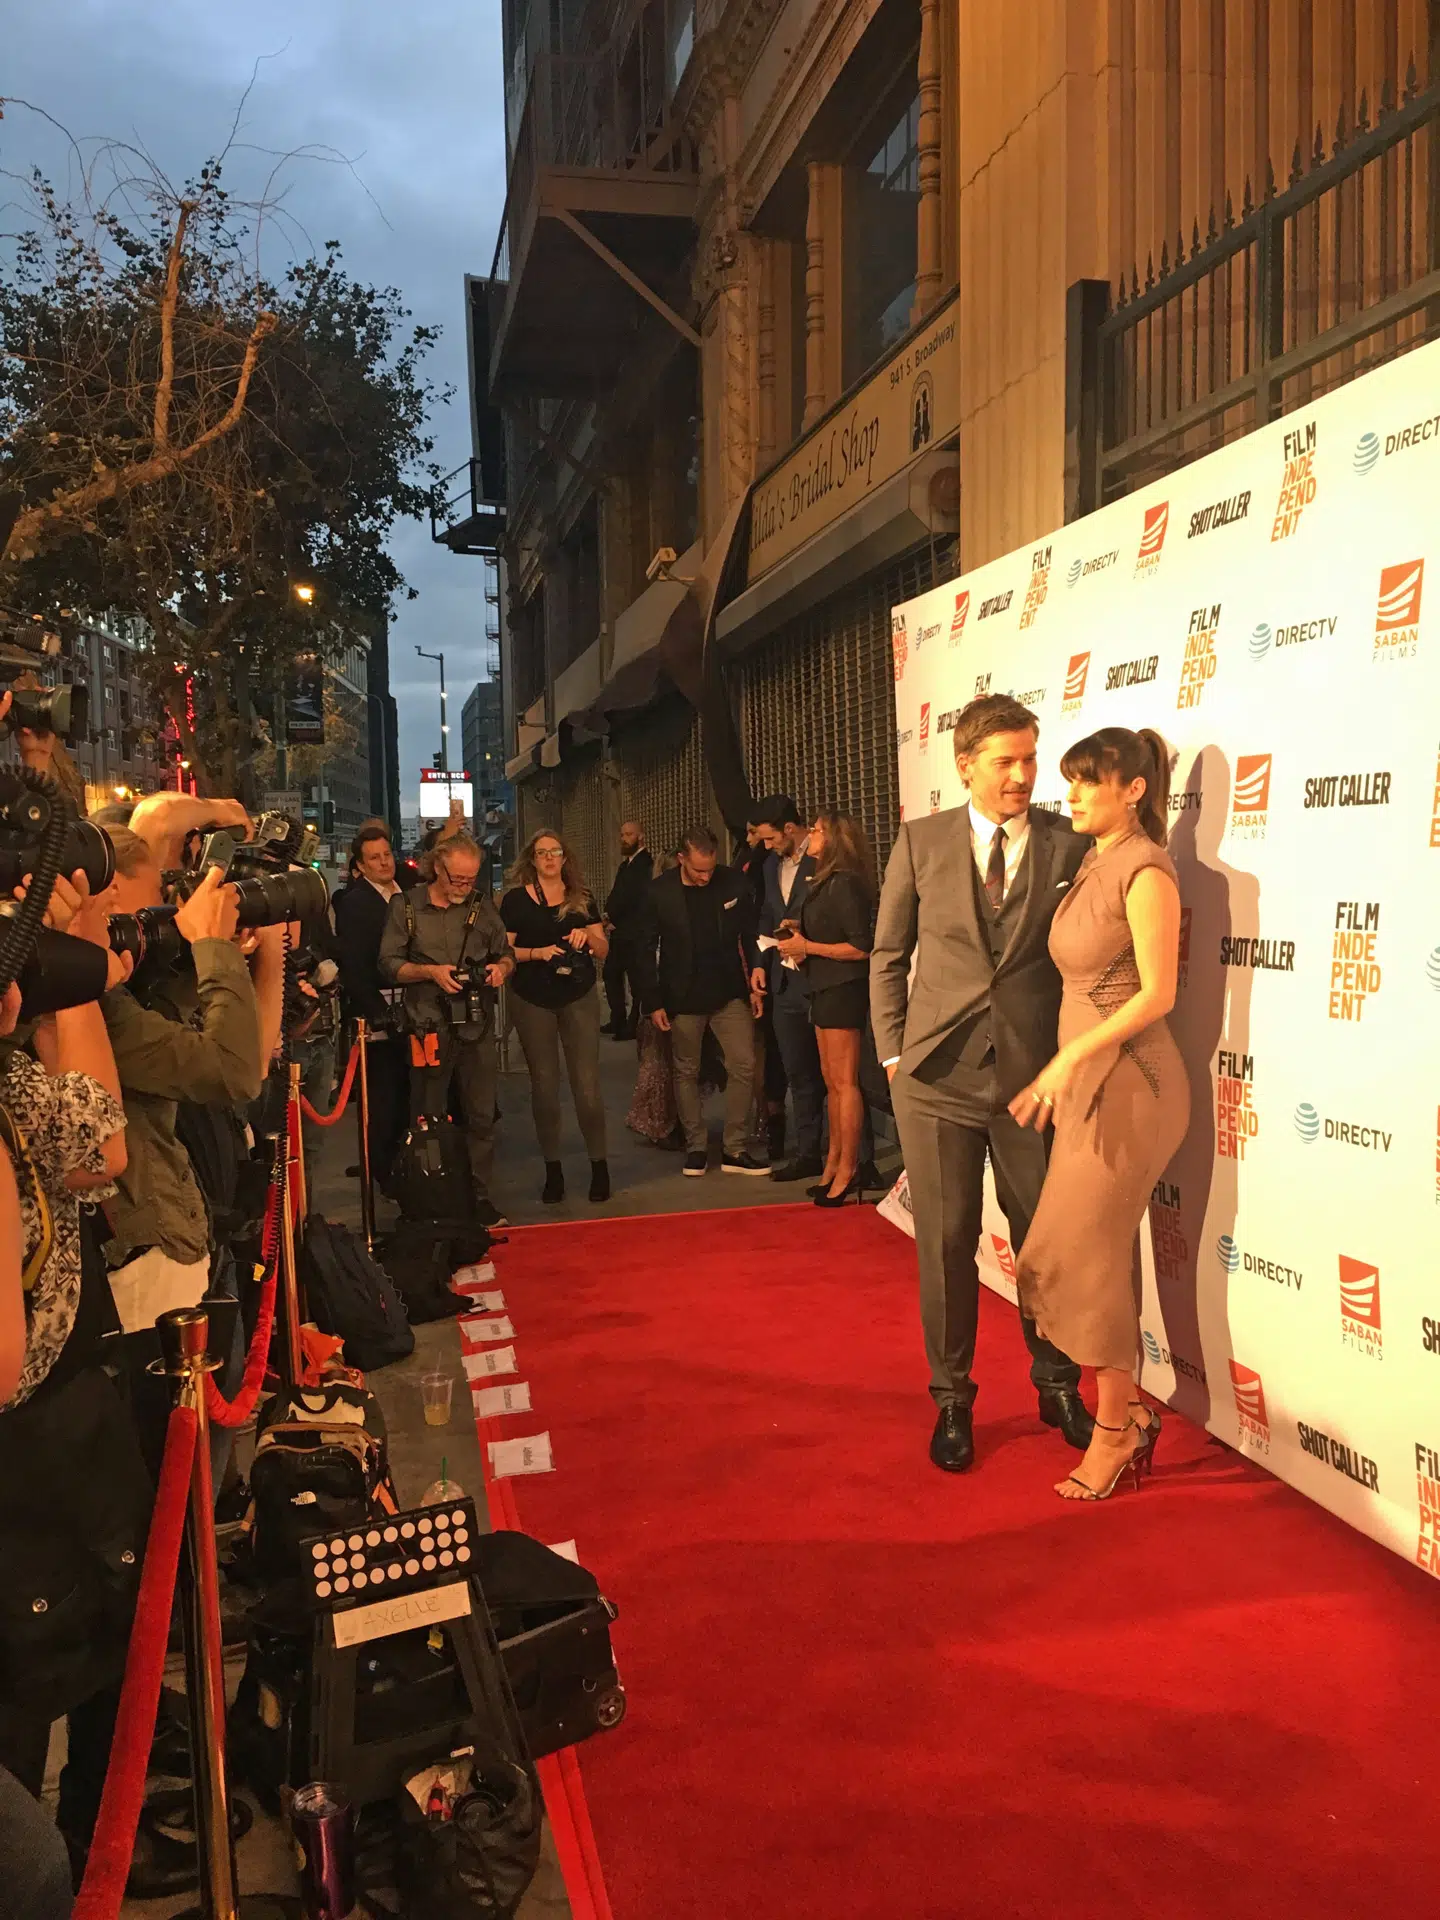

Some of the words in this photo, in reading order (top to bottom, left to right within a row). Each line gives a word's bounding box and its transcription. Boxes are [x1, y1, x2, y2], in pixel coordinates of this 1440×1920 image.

[890, 363, 904, 390] 941
[915, 321, 956, 368] Broadway
[751, 488, 785, 552] ilda's
[790, 430, 836, 522] Bridal
[838, 410, 879, 489] Shop
[1276, 477, 1317, 516] PEND
[1270, 509, 1303, 542] ENT
[1082, 549, 1120, 577] DIRECTV
[1018, 608, 1038, 630] ENT
[1275, 616, 1338, 648] DIRECTV
[1372, 644, 1418, 663] FILMS
[1374, 628, 1418, 650] SABAN
[1180, 654, 1217, 684] PEND
[1176, 682, 1204, 710] ENT
[1232, 814, 1267, 828] SABAN
[1331, 962, 1382, 993] PEND
[1329, 991, 1366, 1022] ENT
[1218, 1104, 1259, 1137] PEND
[1324, 1118, 1393, 1153] DIRECTV
[1218, 1131, 1247, 1161] ENT
[1243, 1252, 1303, 1292] DIRECTV
[1342, 1318, 1382, 1347] SABAN
[1342, 1334, 1383, 1361] FILMS
[1162, 1347, 1207, 1385] DIRECTV
[1238, 1412, 1270, 1443] SABAN
[1238, 1426, 1270, 1456] FILMS
